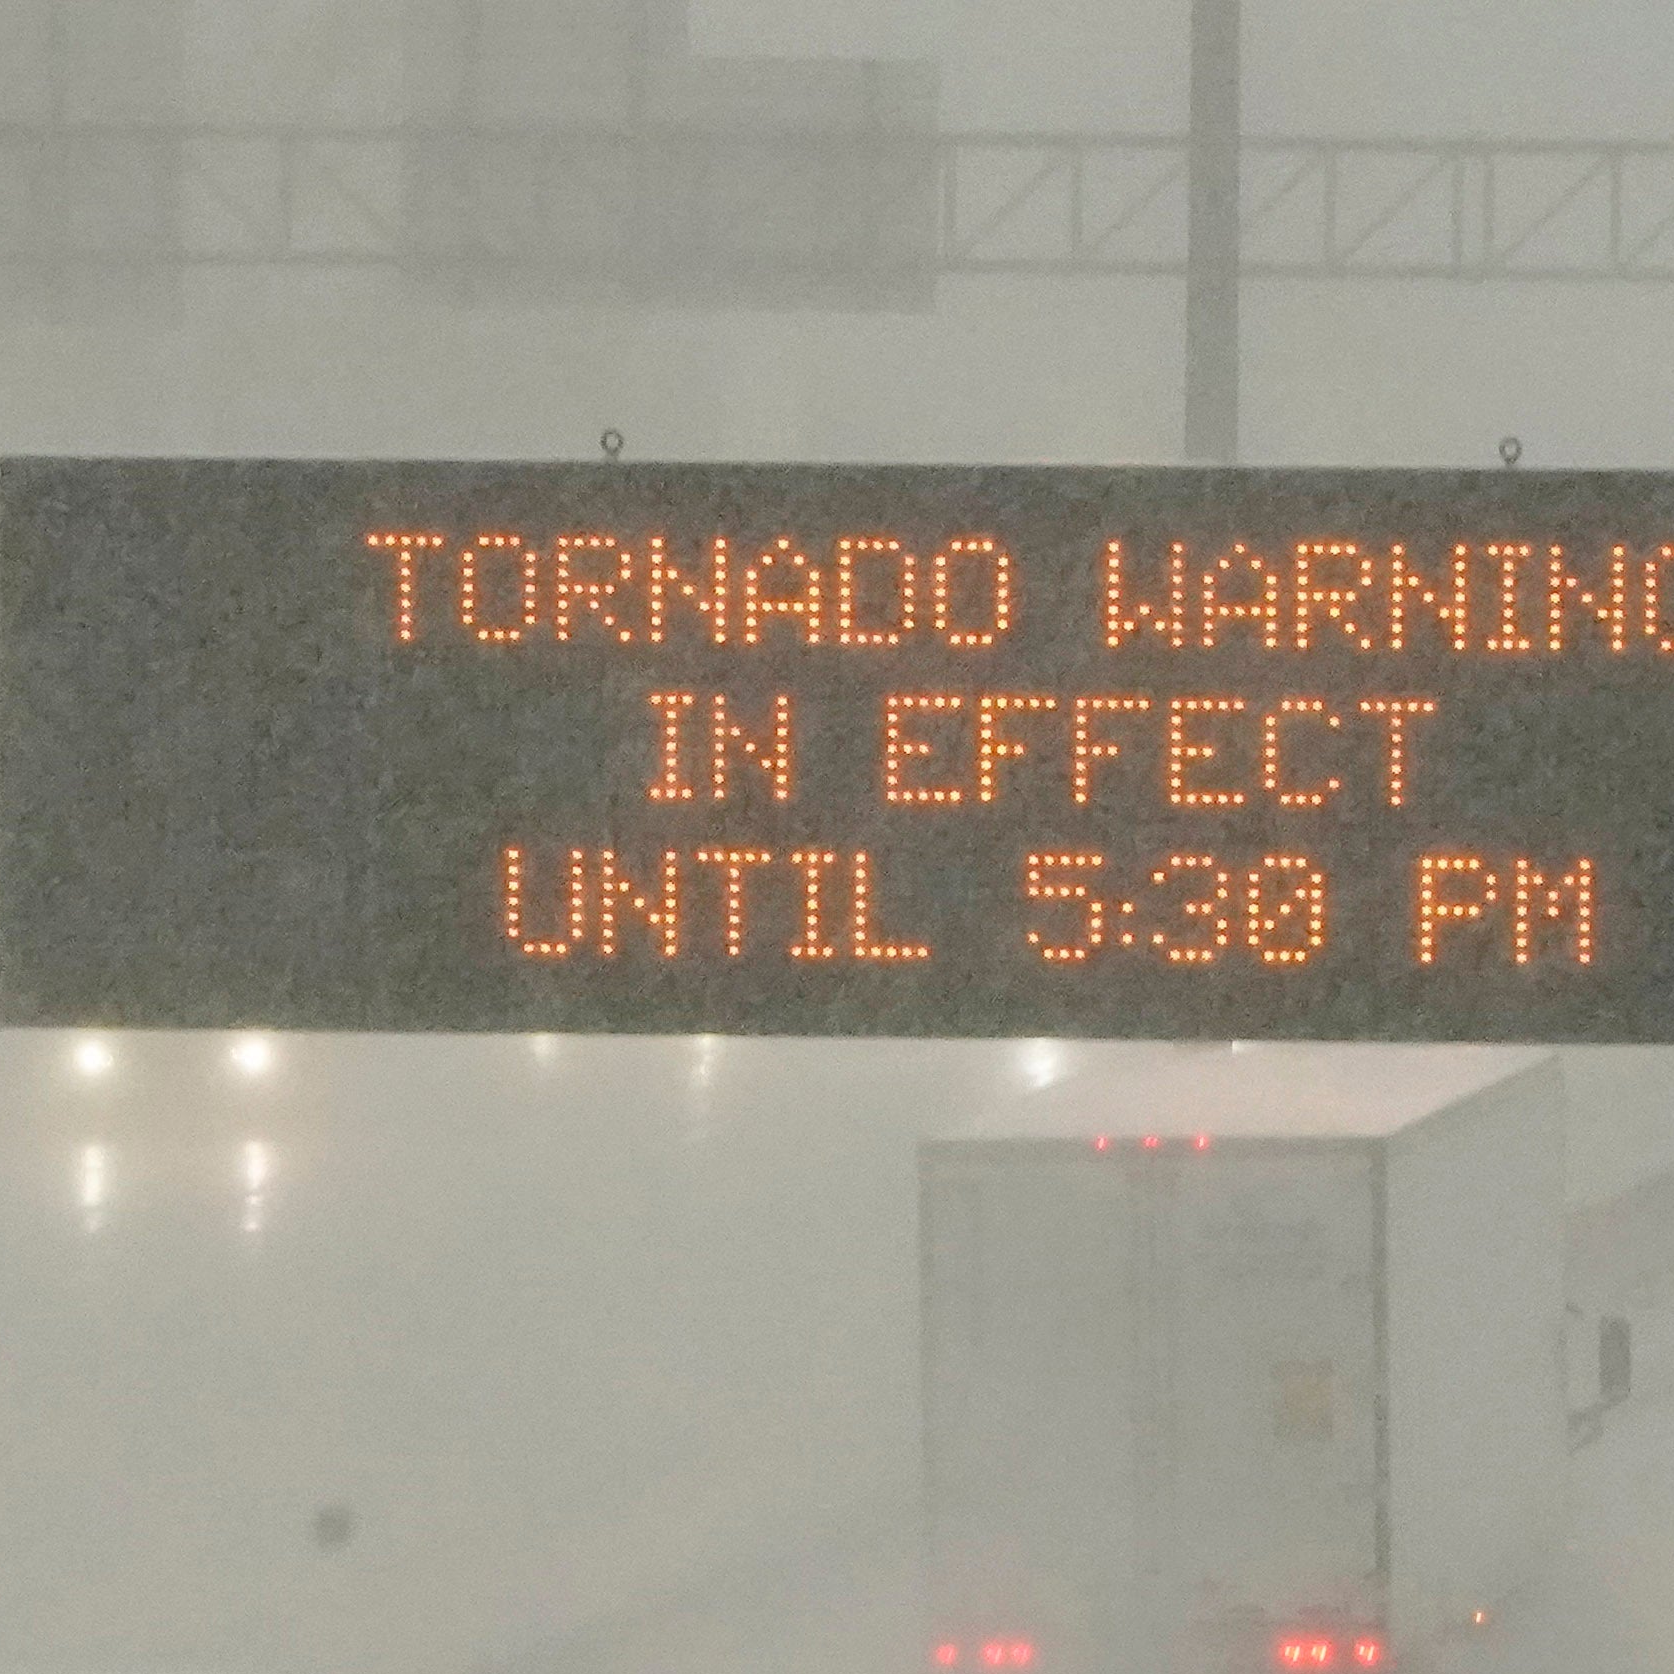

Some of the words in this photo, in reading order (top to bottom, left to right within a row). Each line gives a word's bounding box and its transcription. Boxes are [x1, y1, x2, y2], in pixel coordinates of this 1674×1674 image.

[364, 529, 1019, 652] TORNADO
[644, 688, 796, 804] IN
[879, 689, 1438, 811] EFFECT
[498, 843, 933, 965] UNTIL
[1021, 848, 1331, 968] 5:30
[1411, 849, 1597, 967] PM
